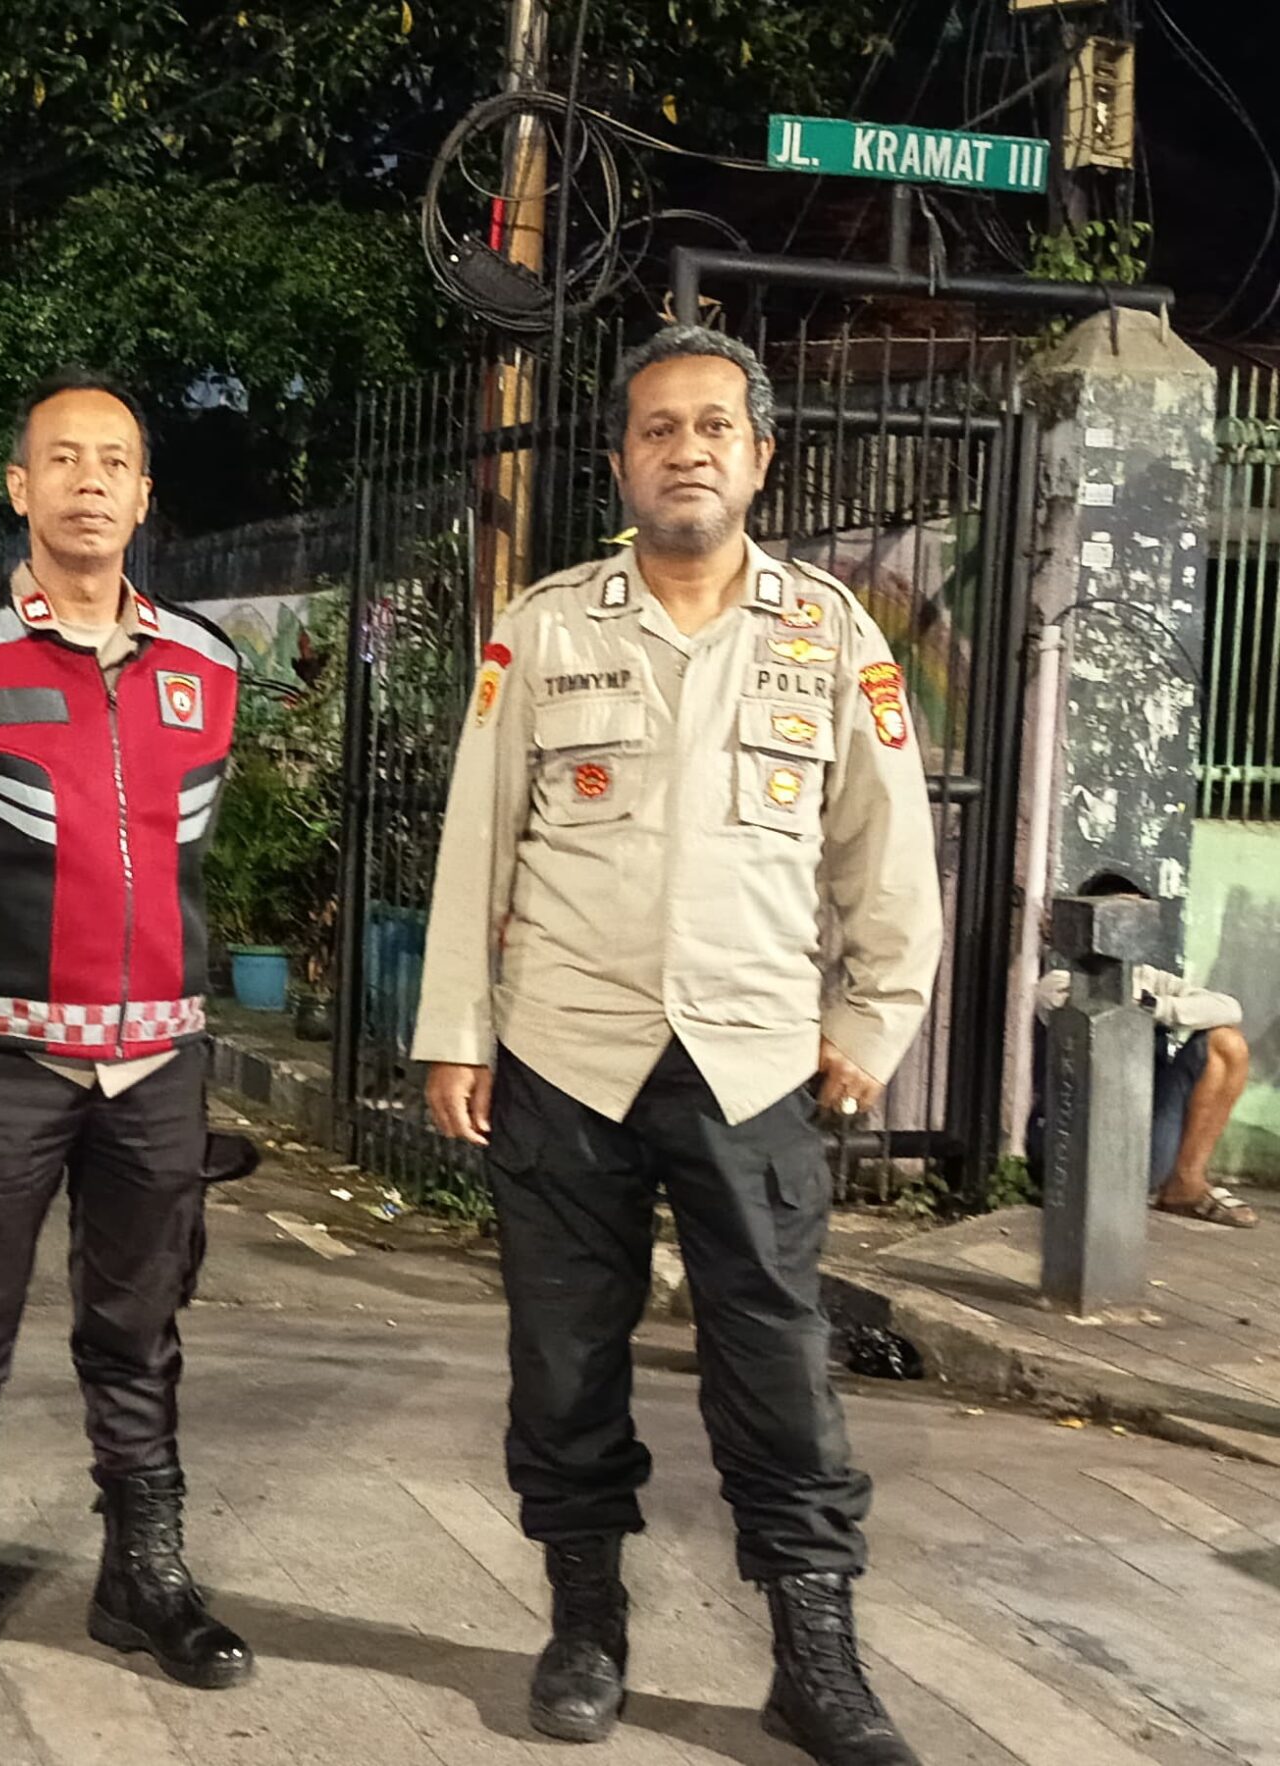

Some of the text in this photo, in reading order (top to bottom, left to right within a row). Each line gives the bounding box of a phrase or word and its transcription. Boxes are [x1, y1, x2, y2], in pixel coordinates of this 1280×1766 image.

[776, 121, 1044, 187] JL. KRAMAT III
[756, 669, 829, 701] POLR
